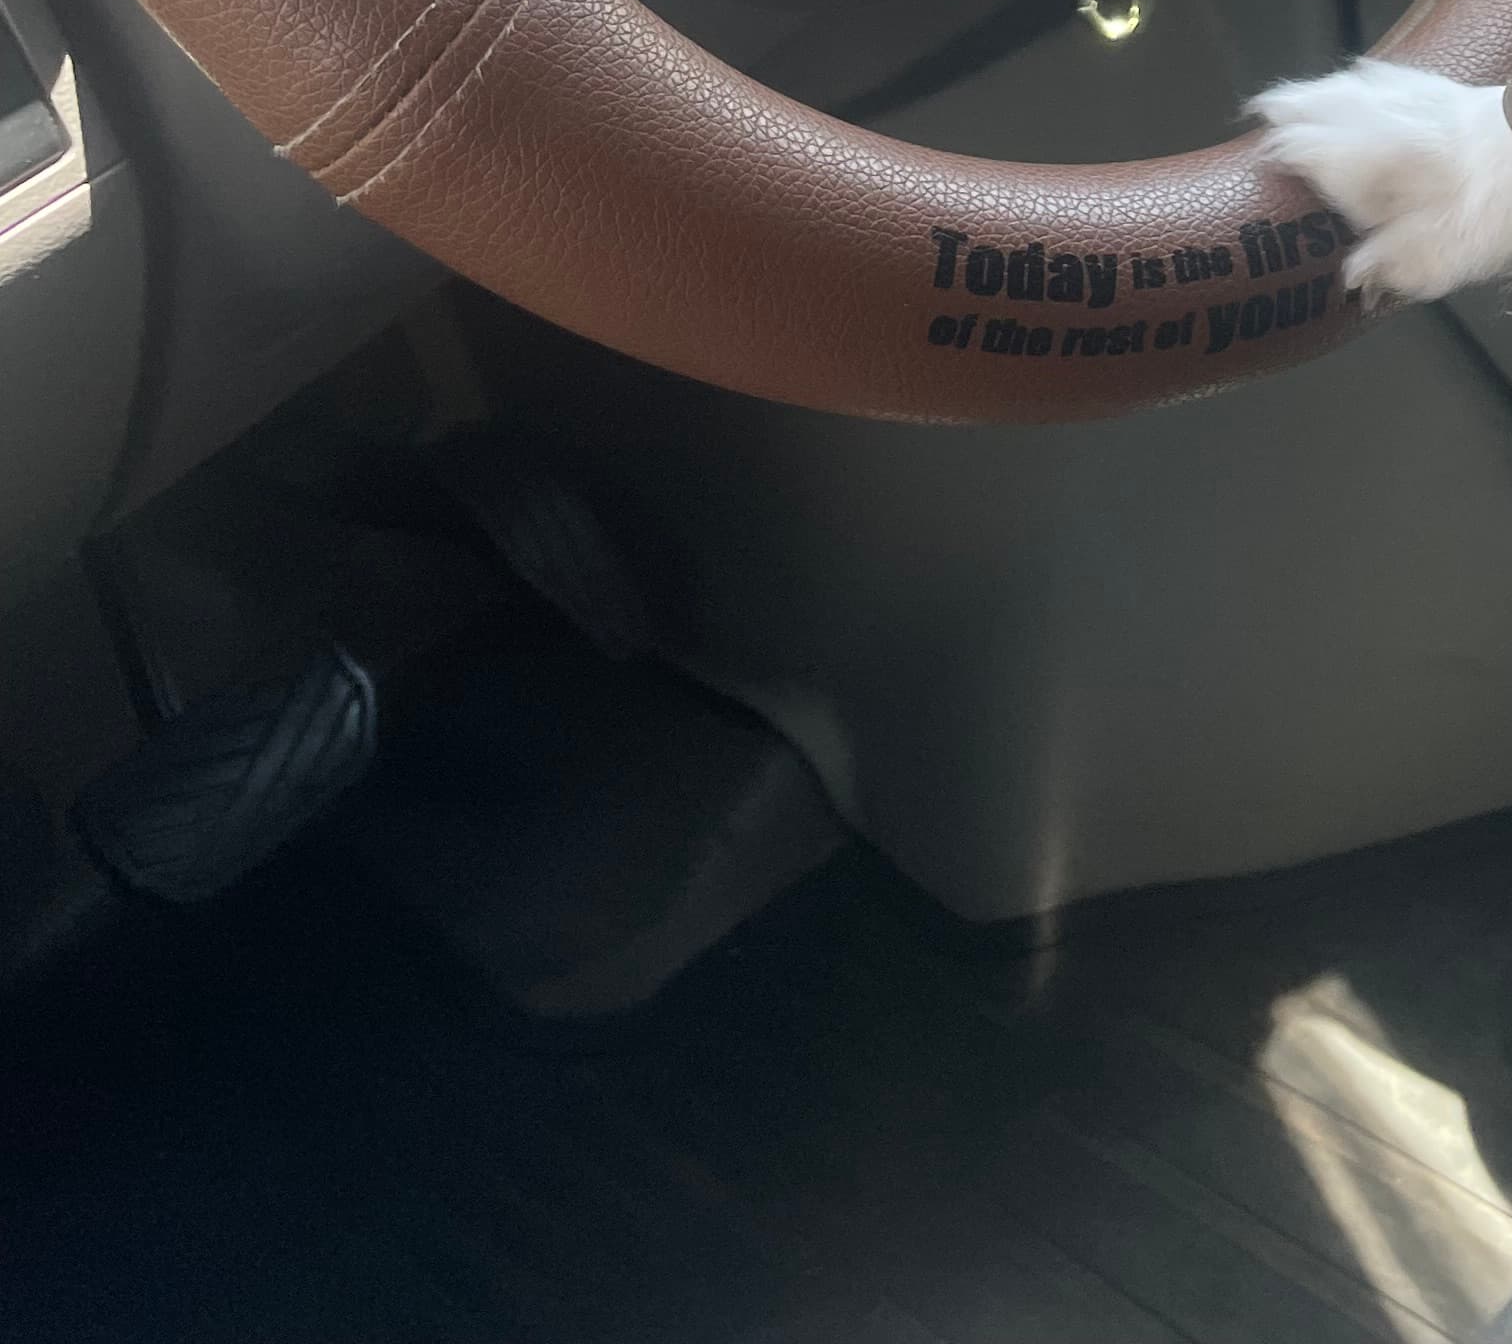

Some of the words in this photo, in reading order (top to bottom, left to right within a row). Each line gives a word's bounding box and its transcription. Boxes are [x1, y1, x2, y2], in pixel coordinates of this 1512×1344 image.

[931, 226, 1118, 309] Today
[1132, 251, 1167, 291] is
[1172, 242, 1234, 284] the
[927, 312, 978, 349] of
[981, 317, 1054, 357] the
[1060, 320, 1149, 357] rest
[1153, 313, 1194, 350] of
[1205, 272, 1335, 354] your
